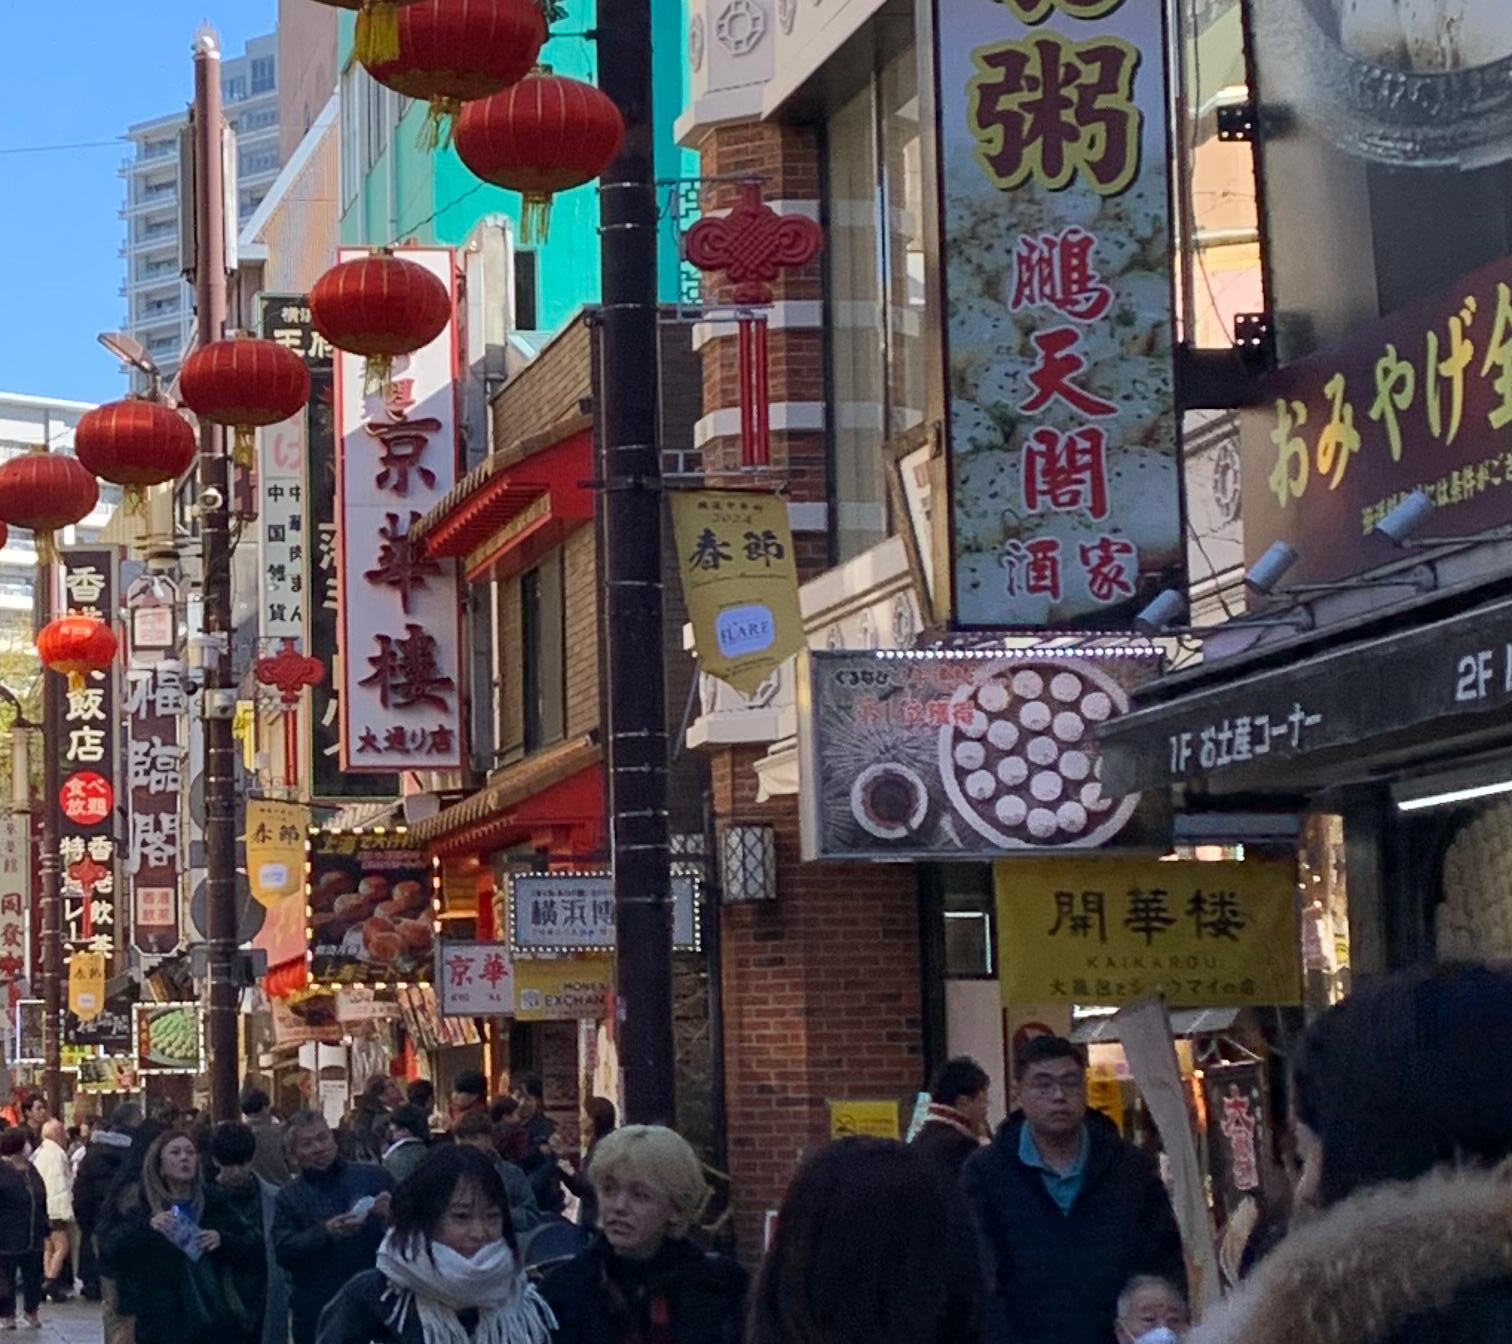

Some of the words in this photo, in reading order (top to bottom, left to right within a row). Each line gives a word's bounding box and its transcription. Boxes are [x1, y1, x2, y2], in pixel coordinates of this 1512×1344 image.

[1010, 230, 1114, 521] 鵬天閣
[689, 527, 786, 570] 春節
[1004, 538, 1136, 606] 酒家
[1455, 651, 1492, 701] 2F
[357, 723, 455, 755] 大通り店
[1199, 702, 1322, 769] お土産コーナー
[1048, 888, 1248, 945] 開華楼
